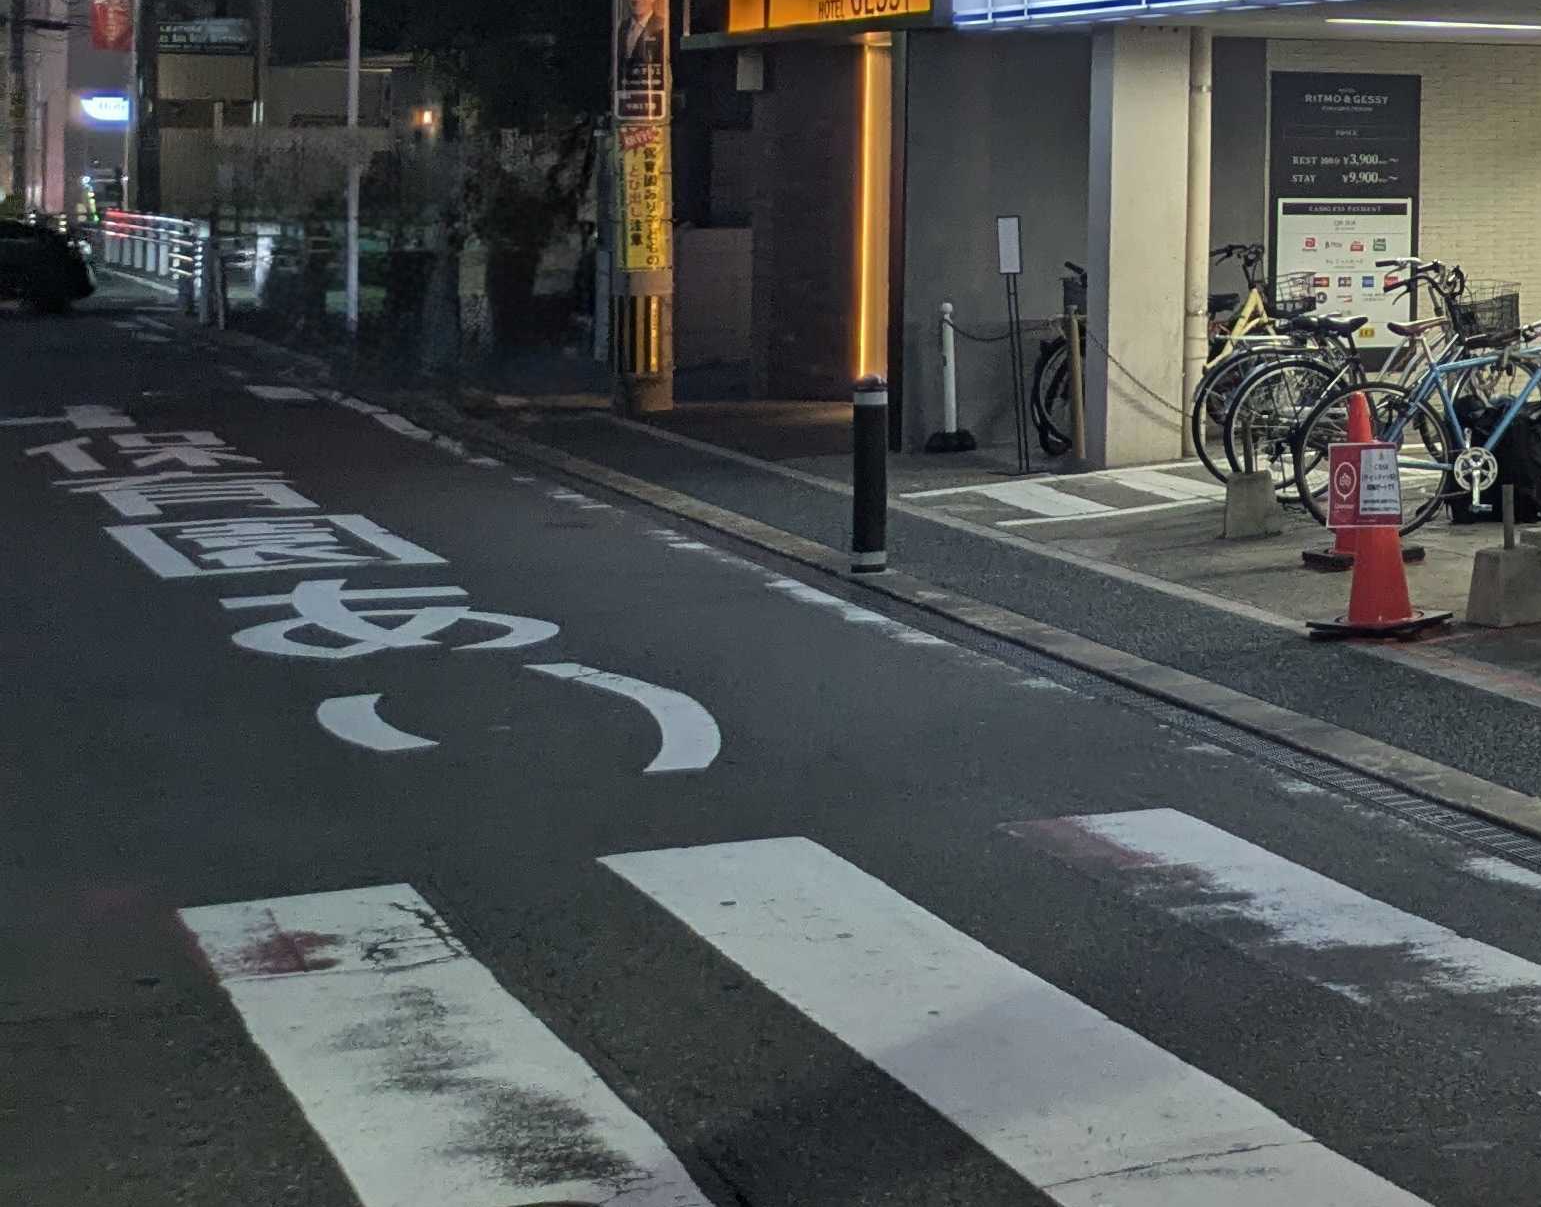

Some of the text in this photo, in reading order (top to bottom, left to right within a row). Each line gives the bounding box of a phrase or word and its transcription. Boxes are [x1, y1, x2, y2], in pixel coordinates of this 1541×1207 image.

[818, 0, 844, 19] HOTEL
[1304, 94, 1341, 103] RITMO
[1353, 95, 1389, 105] GESSY
[1291, 174, 1316, 183] STAY
